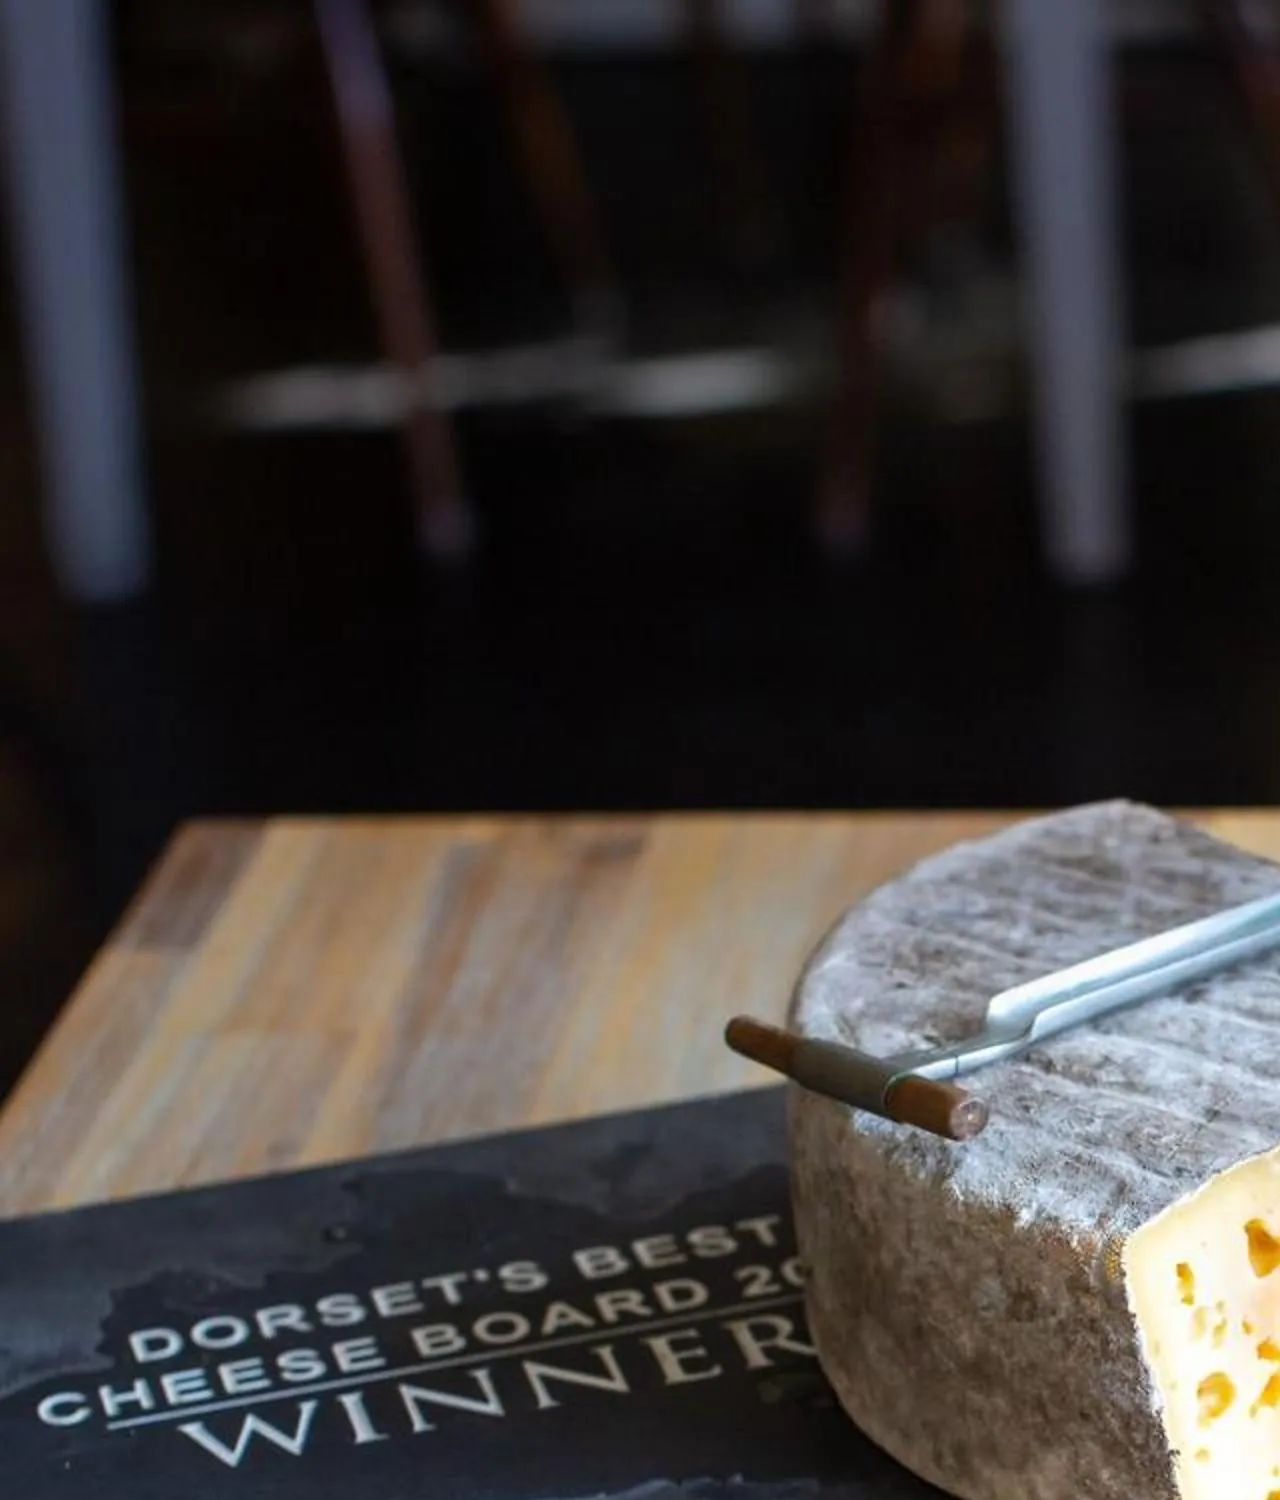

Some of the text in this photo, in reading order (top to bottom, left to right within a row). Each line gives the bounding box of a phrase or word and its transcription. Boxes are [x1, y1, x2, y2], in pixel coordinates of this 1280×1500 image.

[36, 1335, 386, 1427] CHEESE
[409, 1277, 710, 1359] BOARD
[127, 1214, 781, 1364] DORSET'S BEST
[177, 1314, 820, 1469] WINNER
